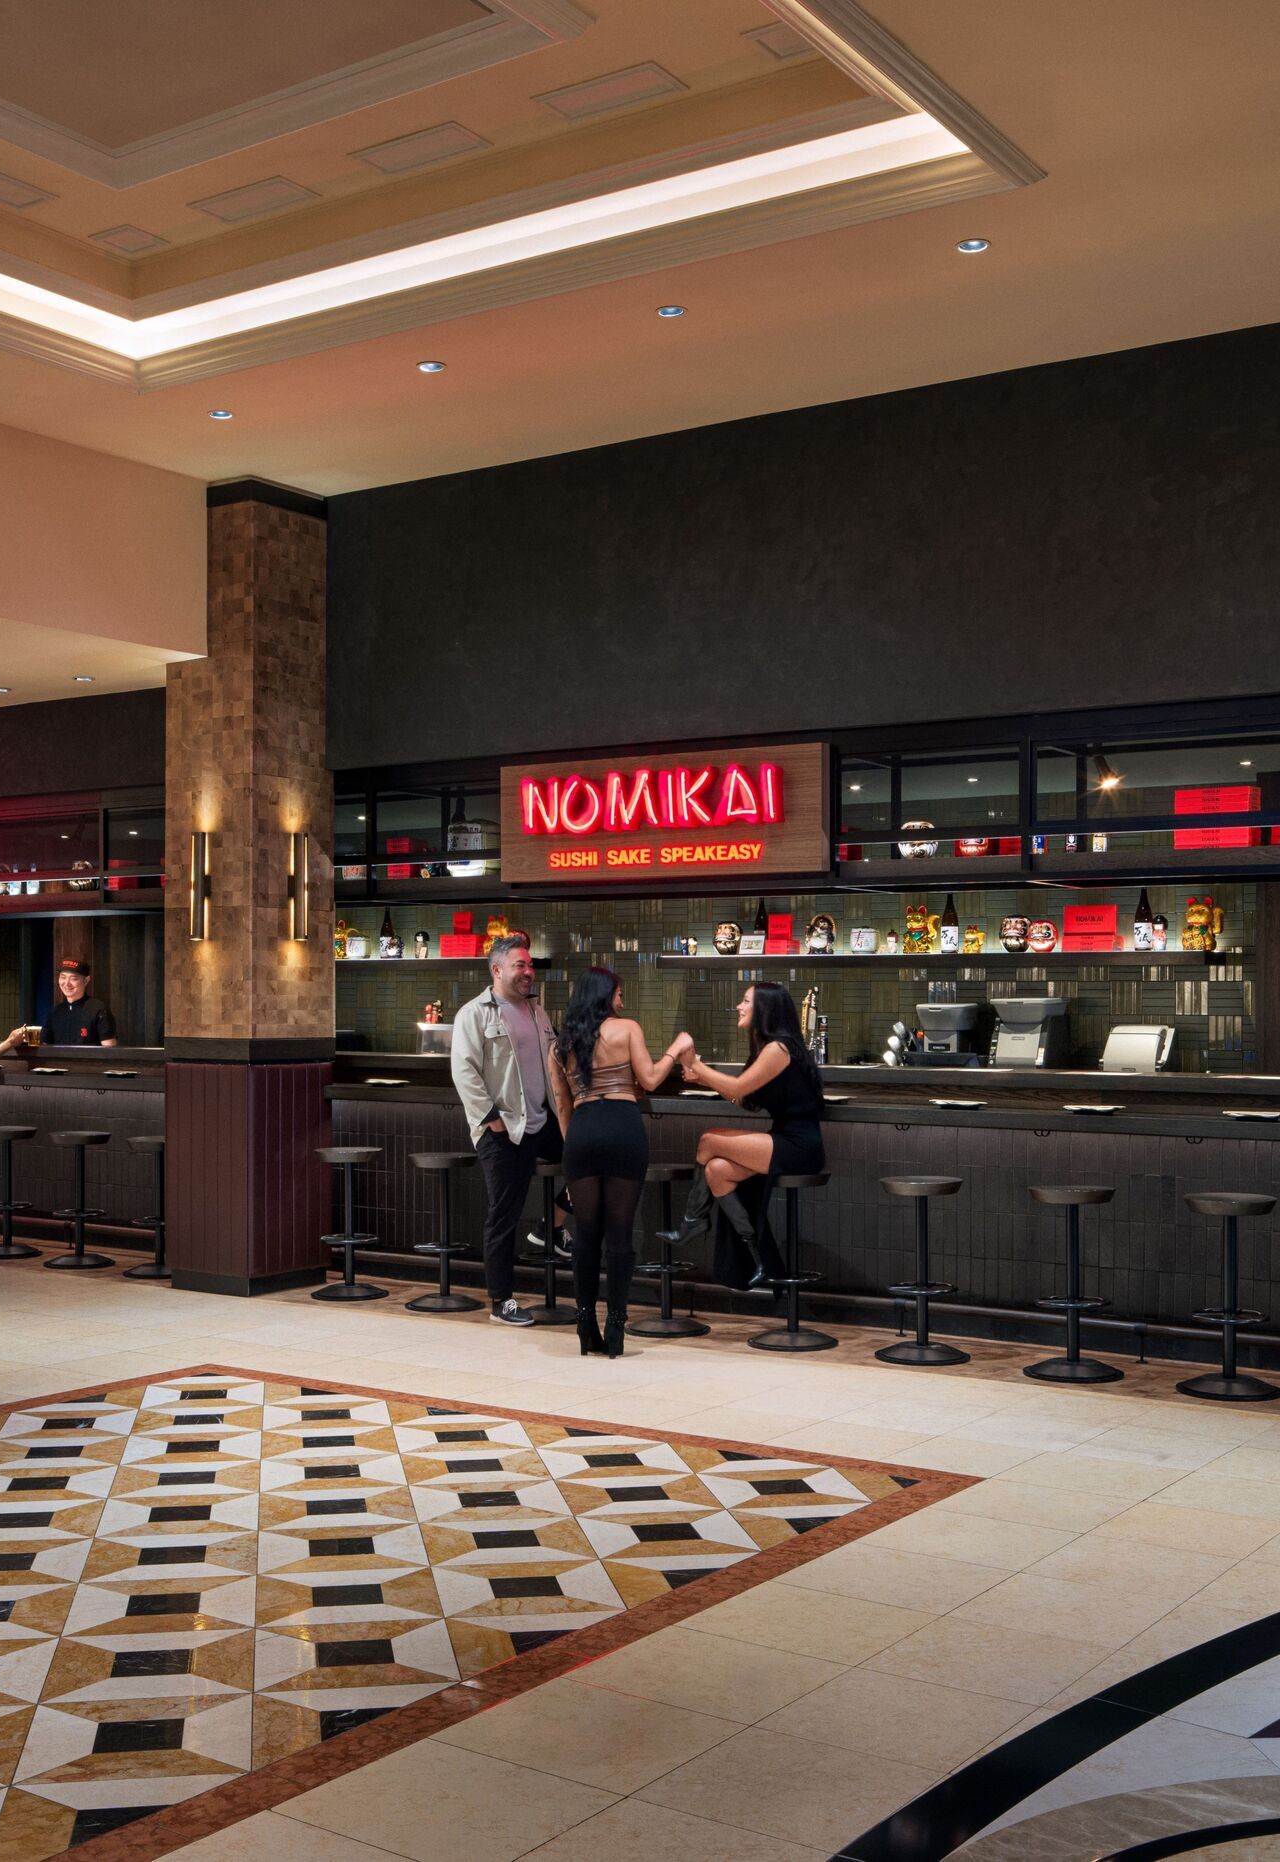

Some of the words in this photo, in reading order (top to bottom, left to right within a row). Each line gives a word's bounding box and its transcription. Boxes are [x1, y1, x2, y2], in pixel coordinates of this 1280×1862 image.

[521, 763, 784, 834] NOMIKAI
[549, 851, 598, 868] SUSHI
[607, 848, 651, 865] SAKE
[660, 843, 762, 863] SPEAKEASY
